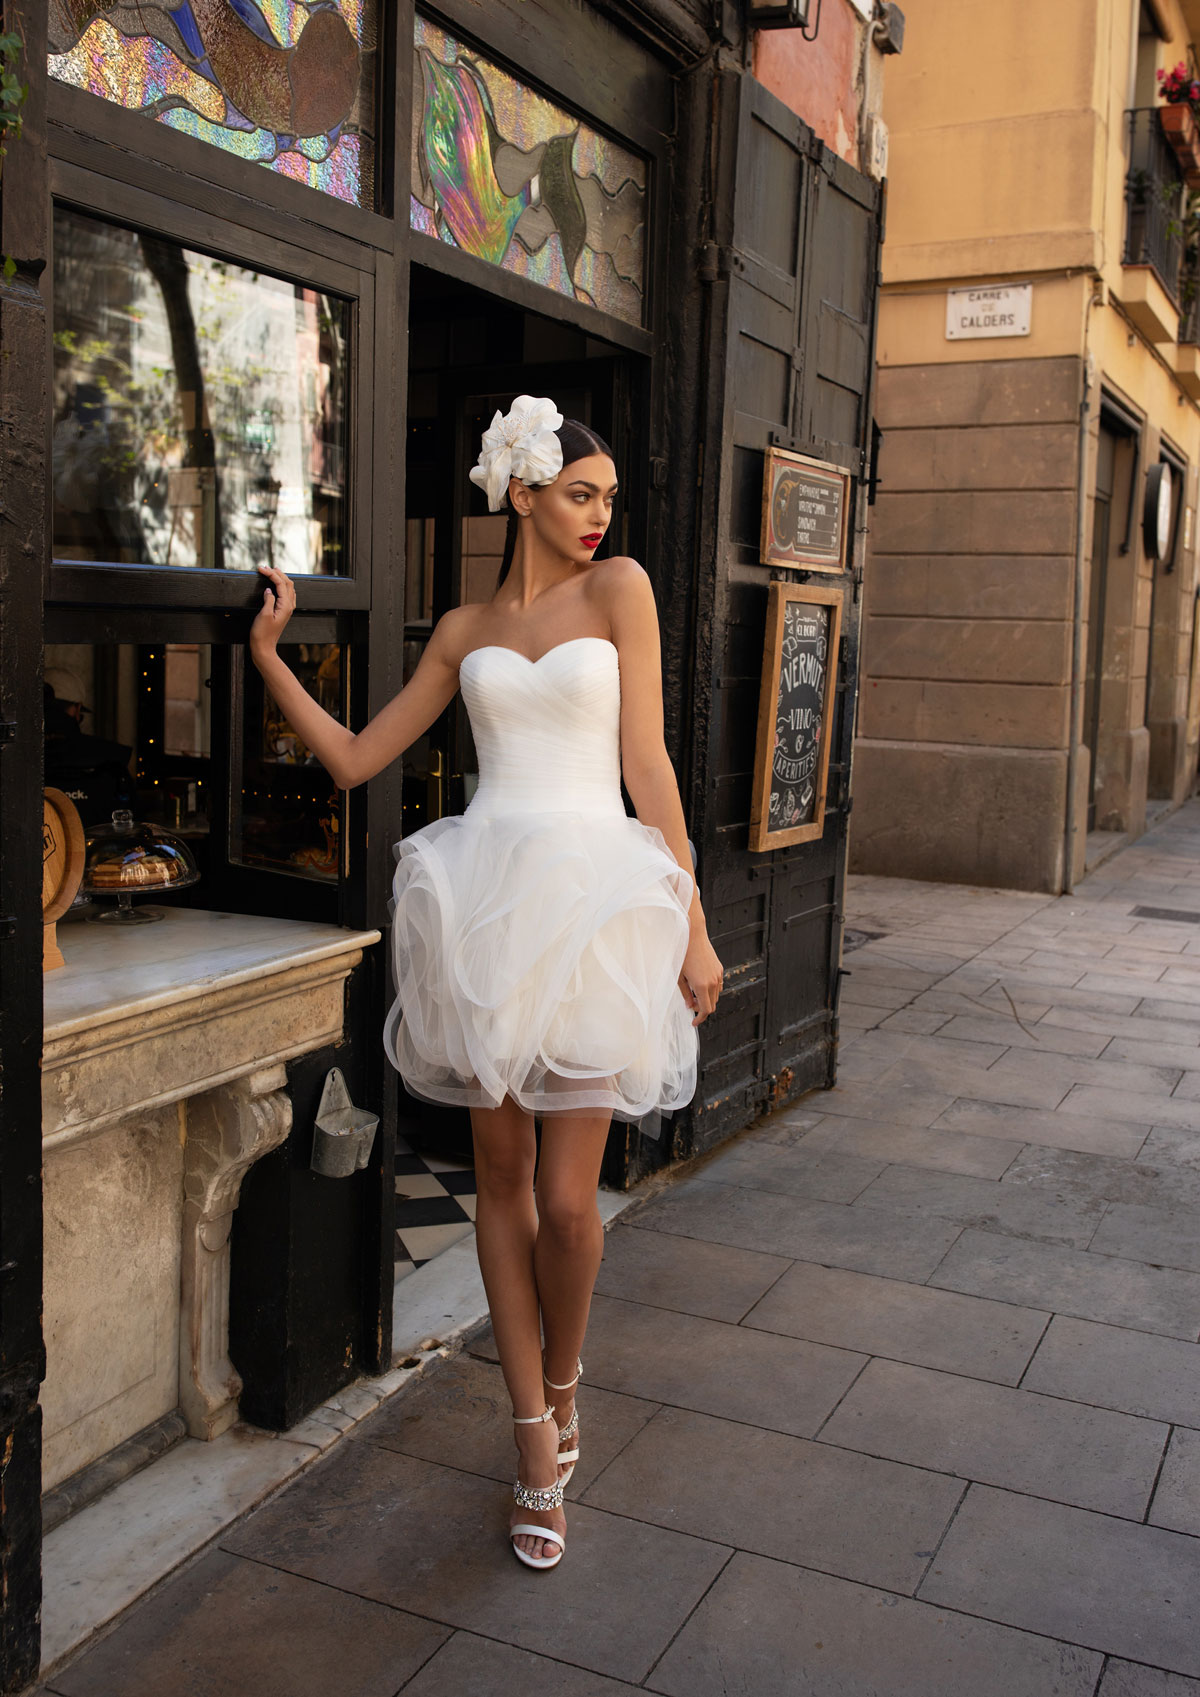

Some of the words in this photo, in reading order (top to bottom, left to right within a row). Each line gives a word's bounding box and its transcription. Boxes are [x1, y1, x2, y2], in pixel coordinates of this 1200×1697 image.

[961, 313, 1015, 329] CALDERS
[784, 652, 823, 692] VERMUT
[790, 708, 813, 730] VINO
[795, 734, 804, 753] &
[776, 752, 815, 779] APERITIFS
